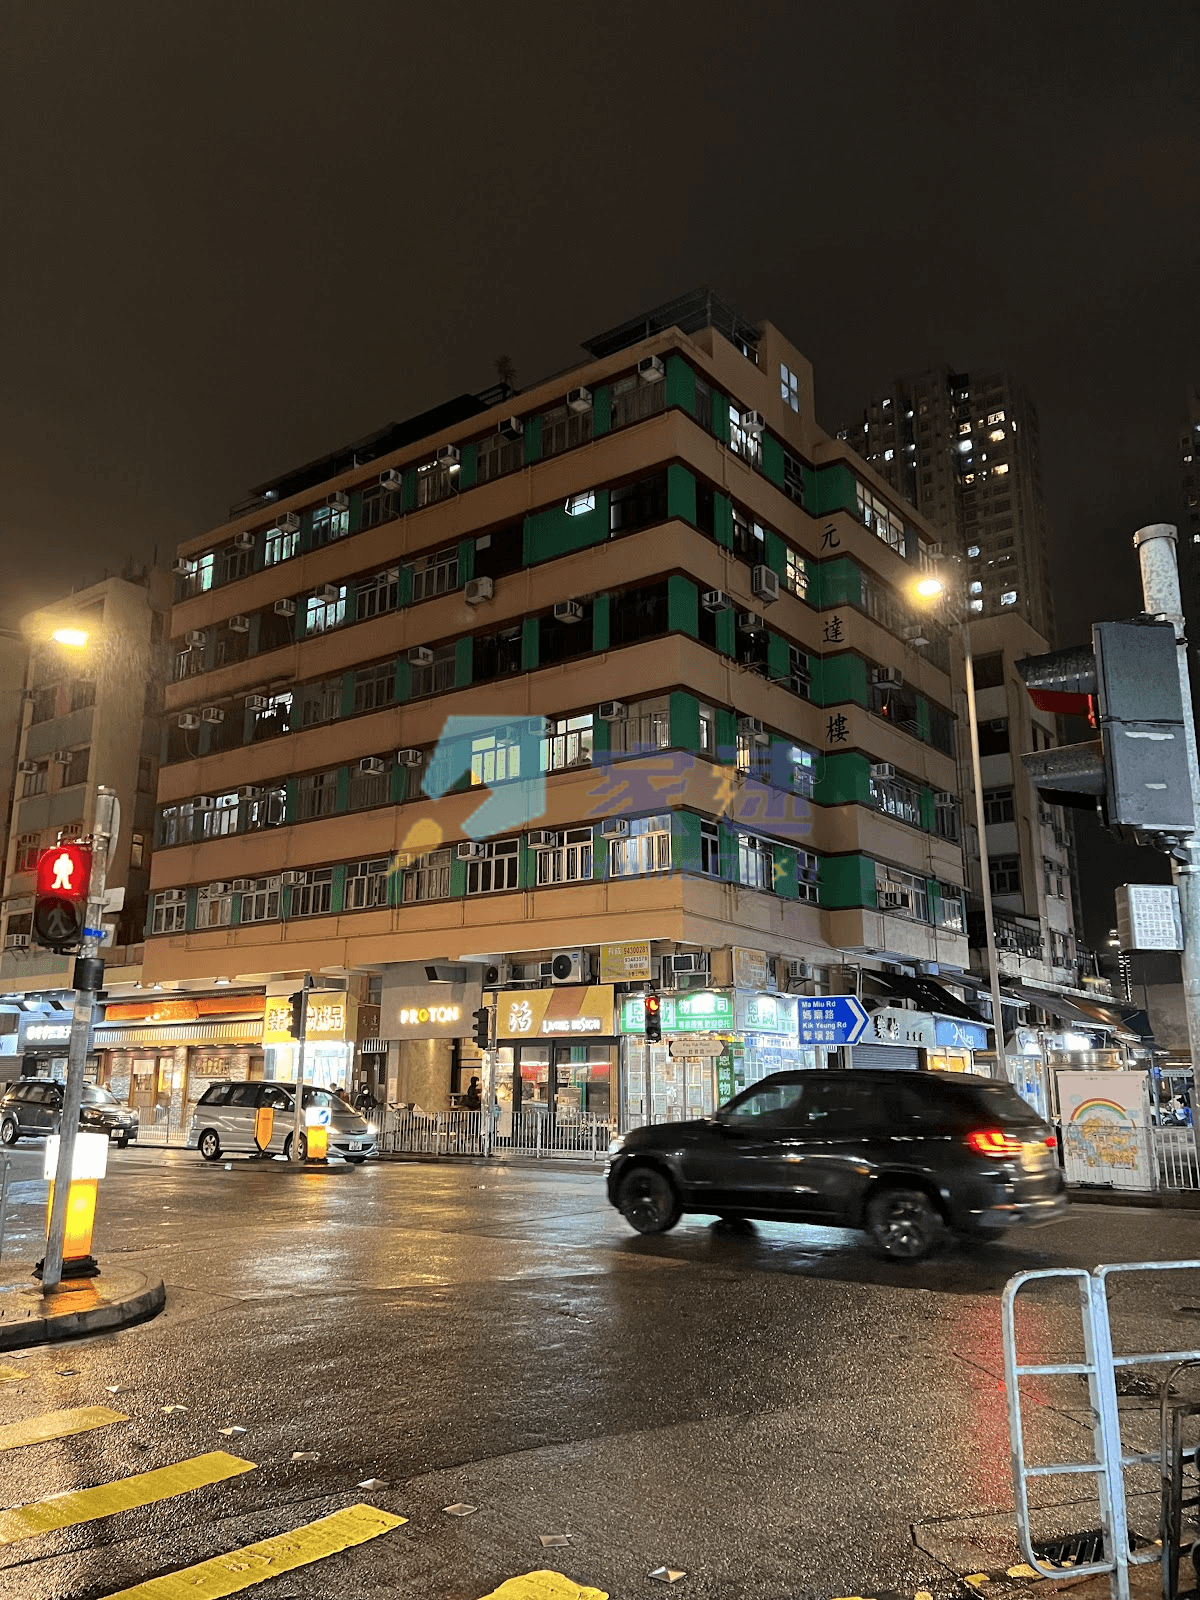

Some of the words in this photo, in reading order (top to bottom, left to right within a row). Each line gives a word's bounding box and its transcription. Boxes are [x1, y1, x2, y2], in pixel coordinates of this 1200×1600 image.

[820, 523, 850, 744] 元達樓
[400, 1006, 460, 1024] PROTON
[815, 1022, 836, 1030] Yeung
